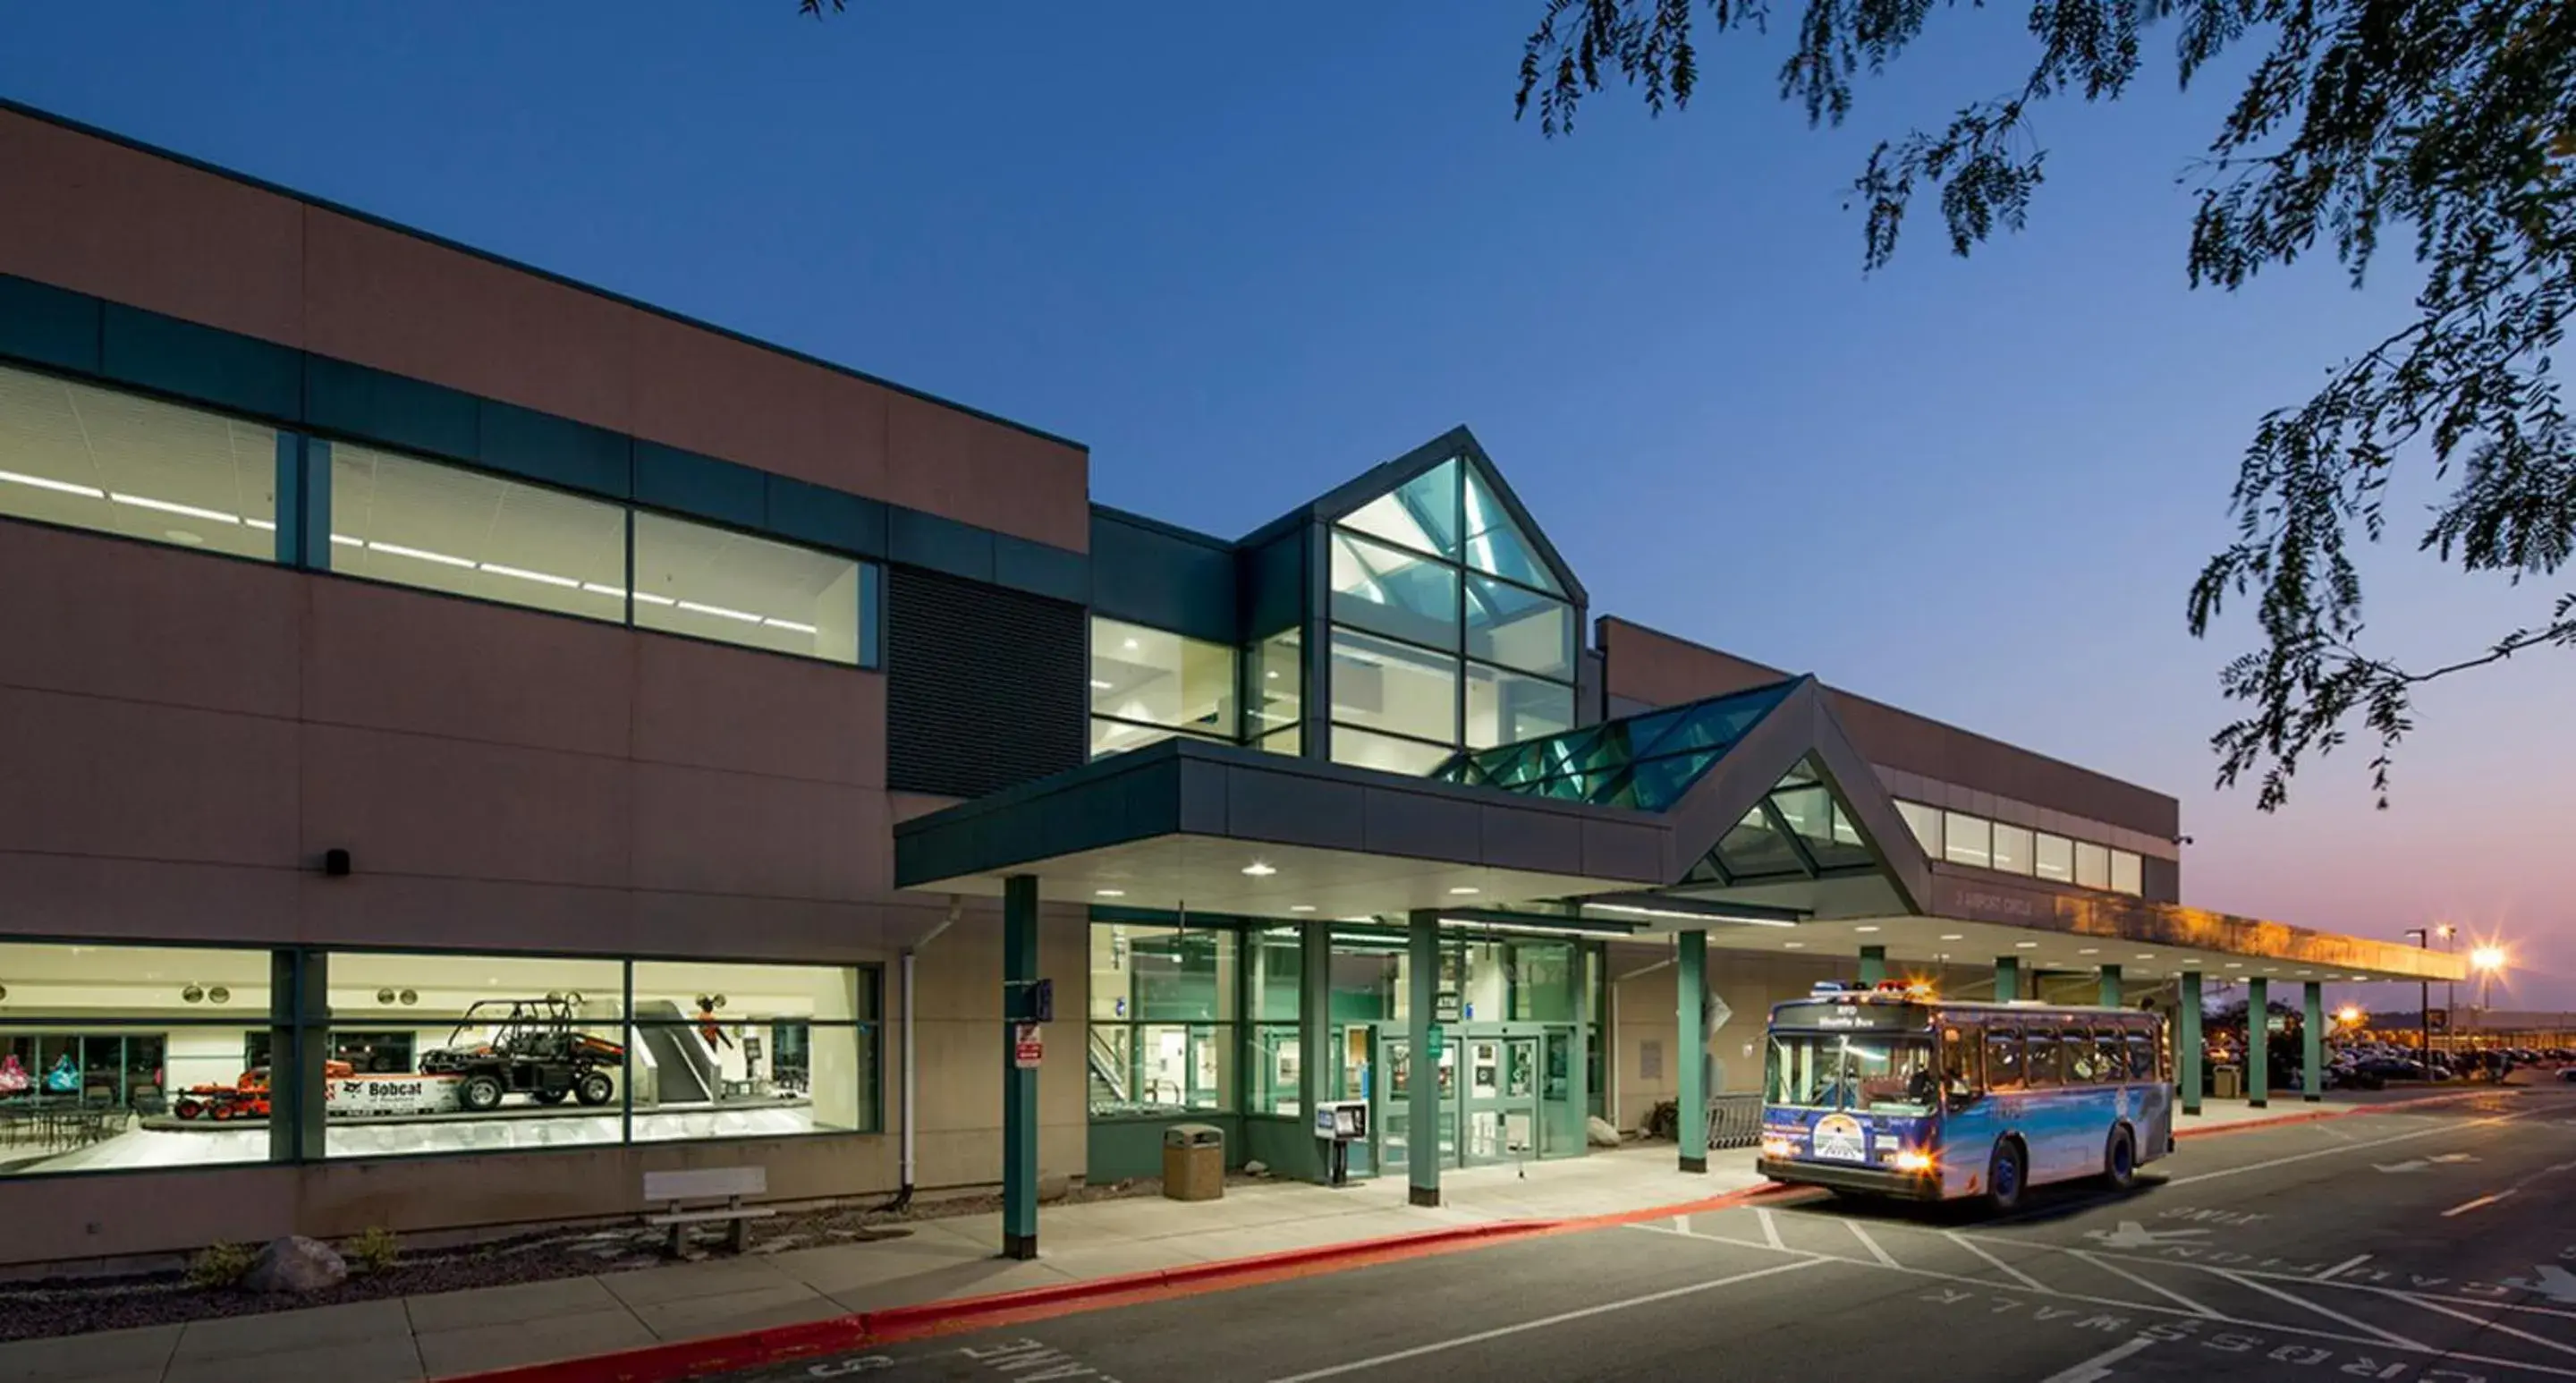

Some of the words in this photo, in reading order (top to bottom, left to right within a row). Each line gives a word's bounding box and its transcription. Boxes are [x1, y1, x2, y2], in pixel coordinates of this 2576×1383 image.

[1818, 1016, 1852, 1030] Shuttle
[1854, 1016, 1875, 1027] Bus
[369, 1081, 422, 1097] Bobcat
